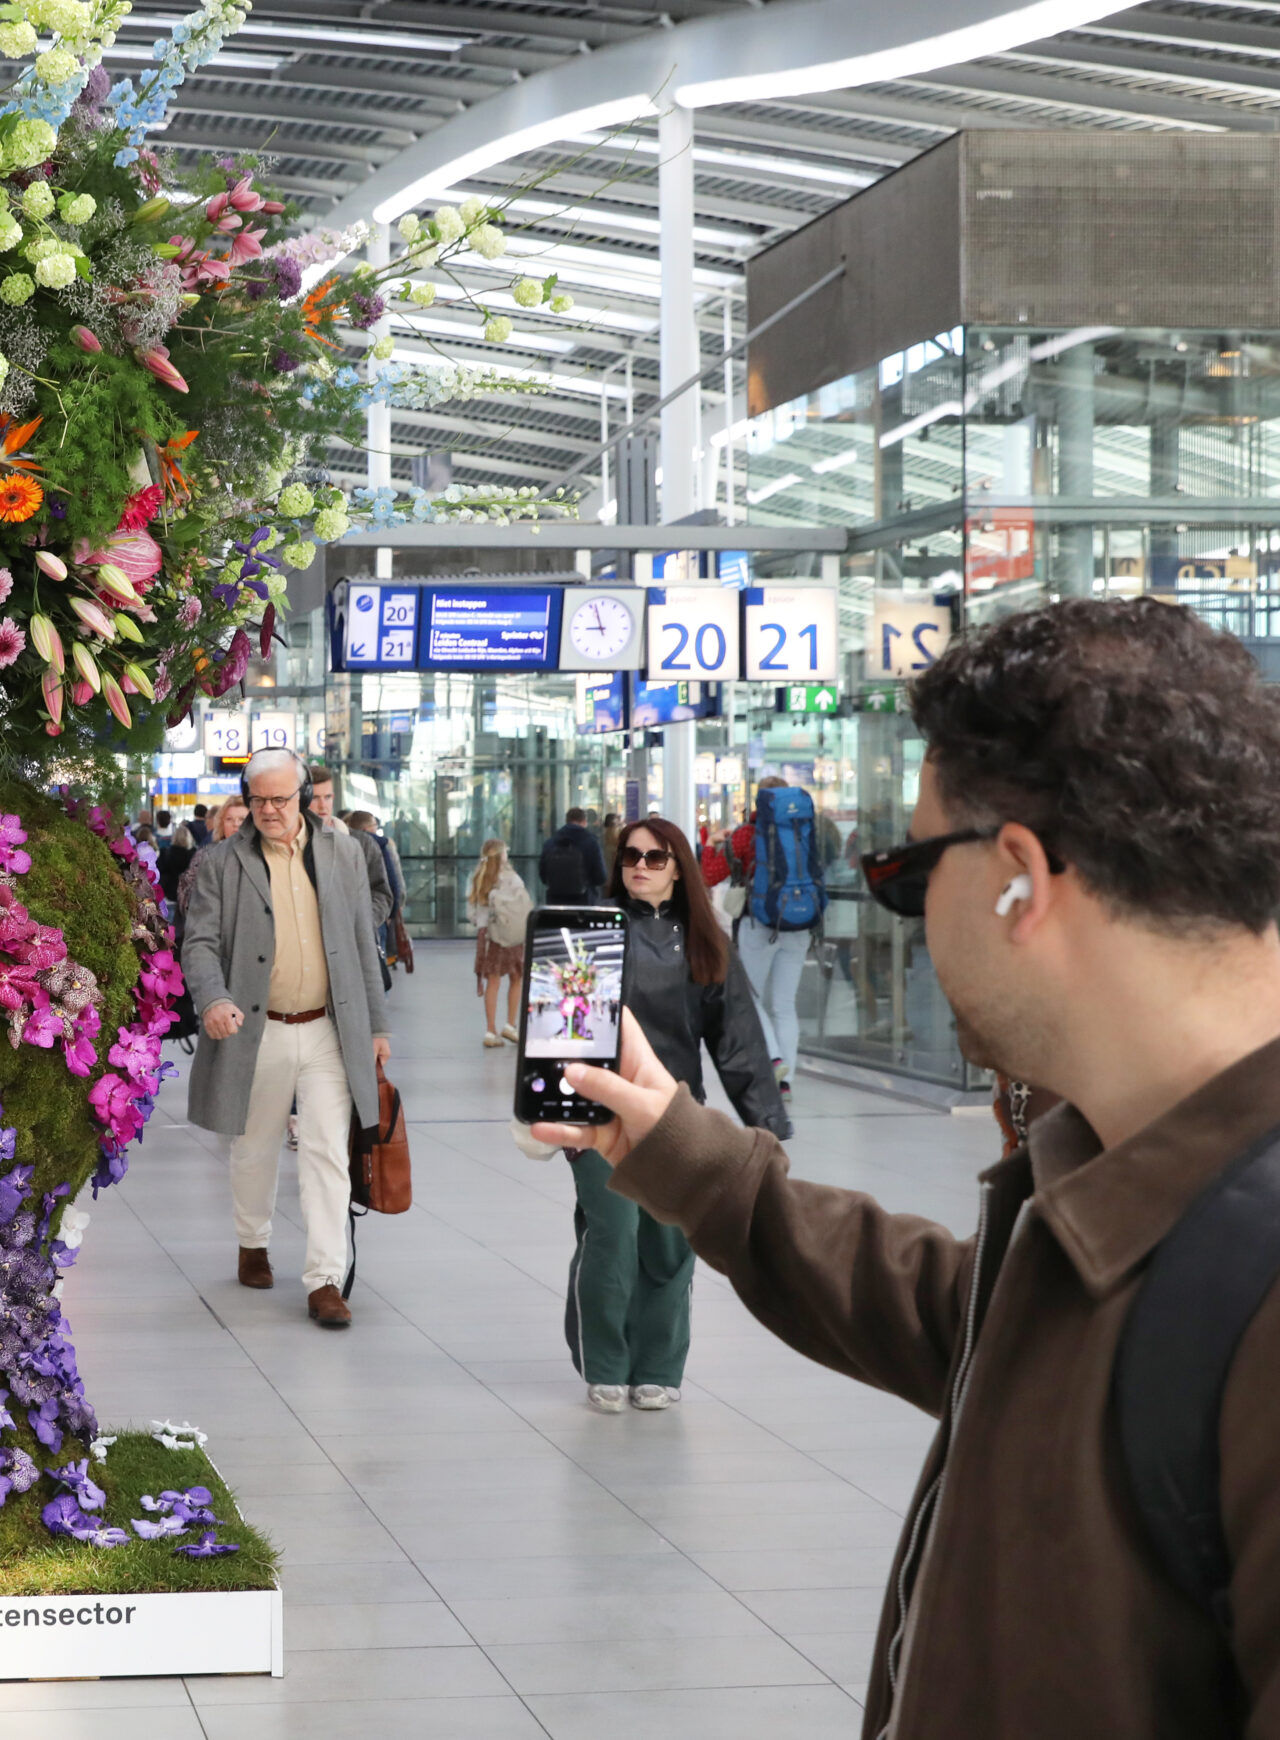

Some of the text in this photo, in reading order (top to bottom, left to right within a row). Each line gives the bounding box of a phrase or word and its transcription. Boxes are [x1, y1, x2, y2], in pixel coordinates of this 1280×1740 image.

[661, 623, 726, 670] 20
[759, 623, 818, 670] 21
[213, 728, 240, 751] 18
[260, 728, 287, 749] 19
